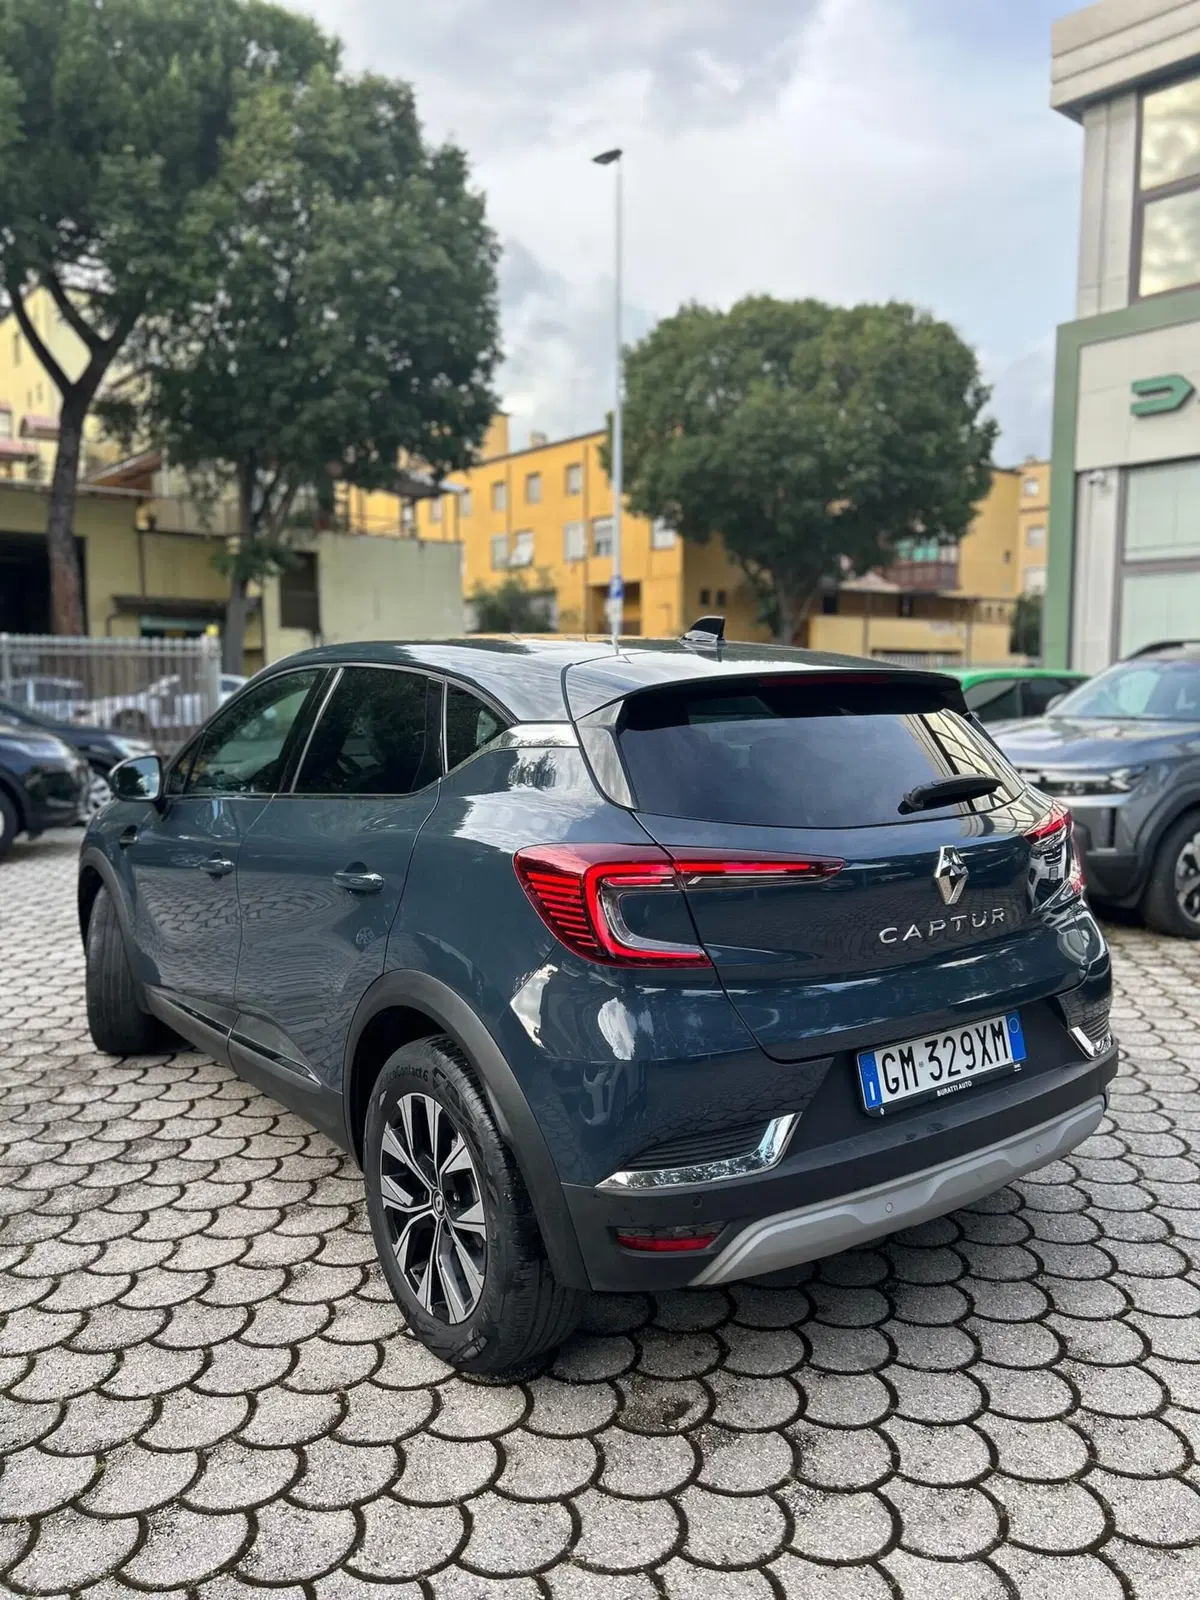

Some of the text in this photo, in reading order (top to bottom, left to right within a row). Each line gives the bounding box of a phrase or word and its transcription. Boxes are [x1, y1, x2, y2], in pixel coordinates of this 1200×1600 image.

[879, 907, 1006, 944] CAPTUR
[881, 1021, 1009, 1094] GM 329XM
[936, 1080, 973, 1097] BURATTI AUTO
